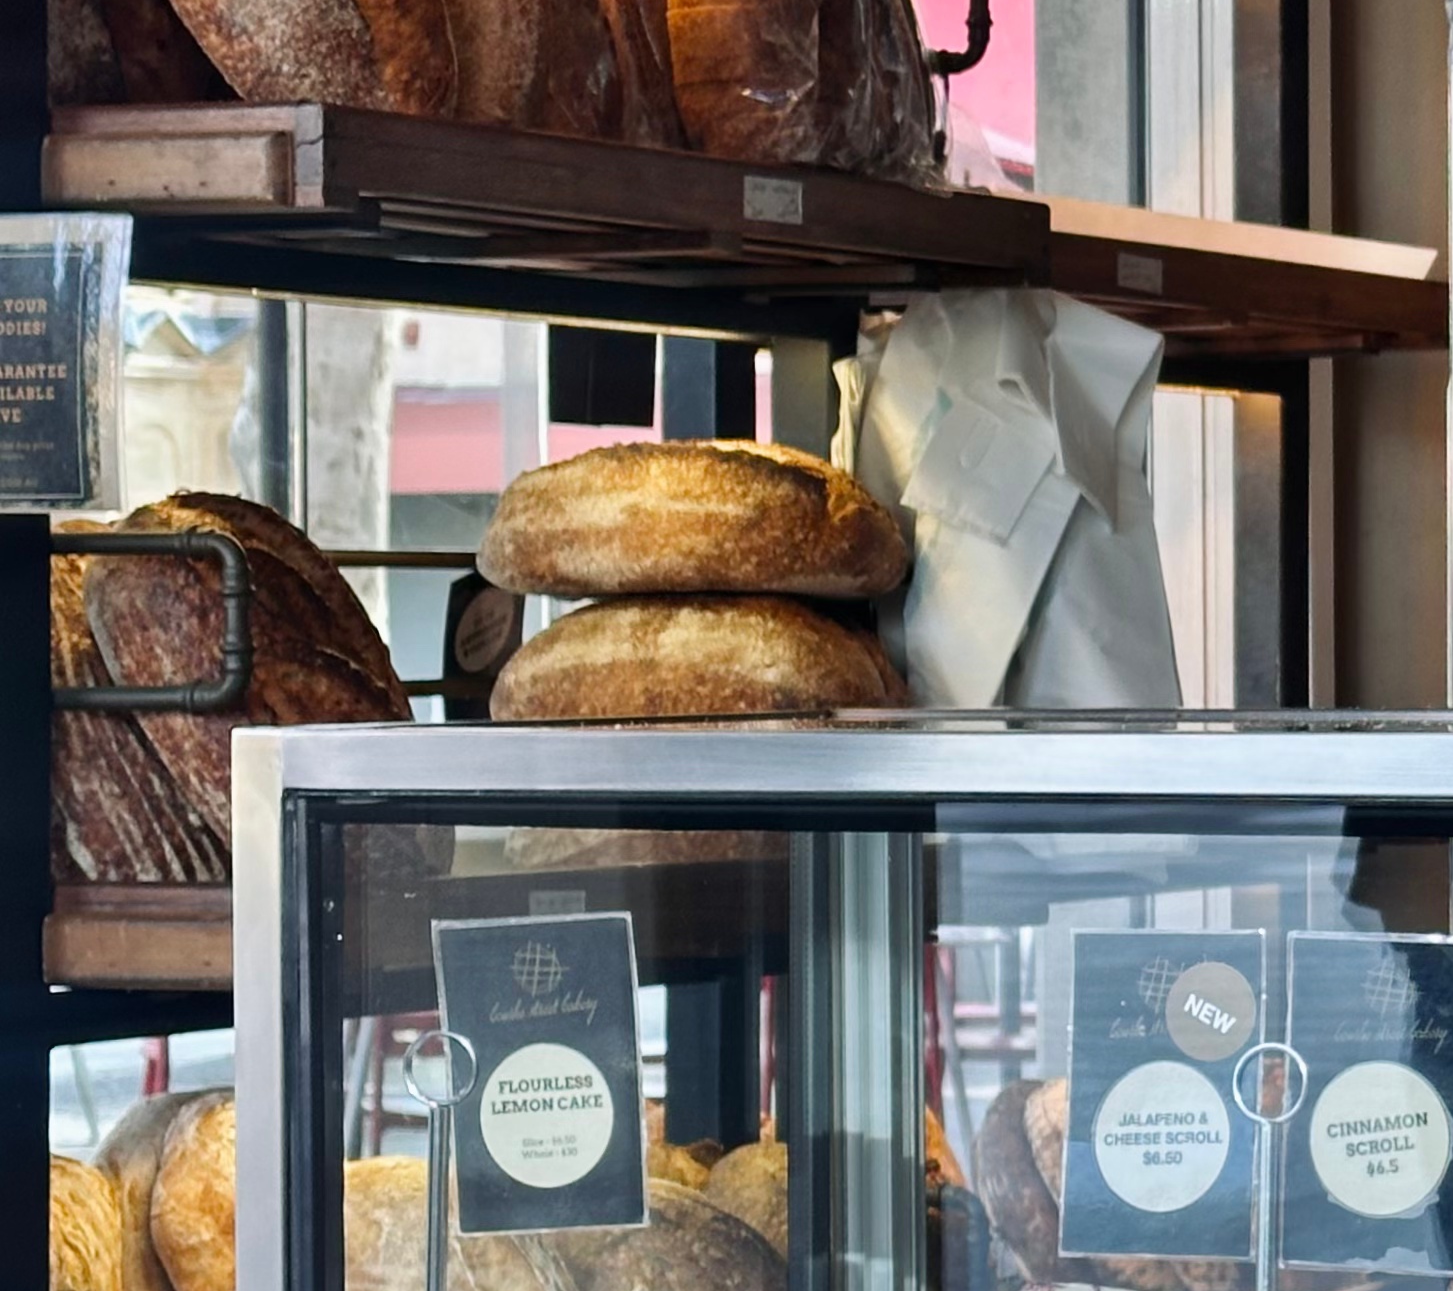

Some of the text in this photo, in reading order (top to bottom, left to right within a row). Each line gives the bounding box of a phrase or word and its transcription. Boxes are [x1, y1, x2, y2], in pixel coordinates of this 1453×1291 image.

[3, 298, 48, 314] YOUR
[1183, 993, 1238, 1035] NEW
[498, 1074, 594, 1095] FLOURLESS
[491, 1093, 604, 1116] LEMON CAKE
[1198, 1111, 1208, 1126] &
[1326, 1112, 1429, 1140] CINNAMON
[1104, 1130, 1223, 1146] CHEESE SCROLL
[1142, 1149, 1183, 1166] $6.50
[1344, 1138, 1416, 1158] SCROLL
[1366, 1159, 1400, 1178] $6.5
